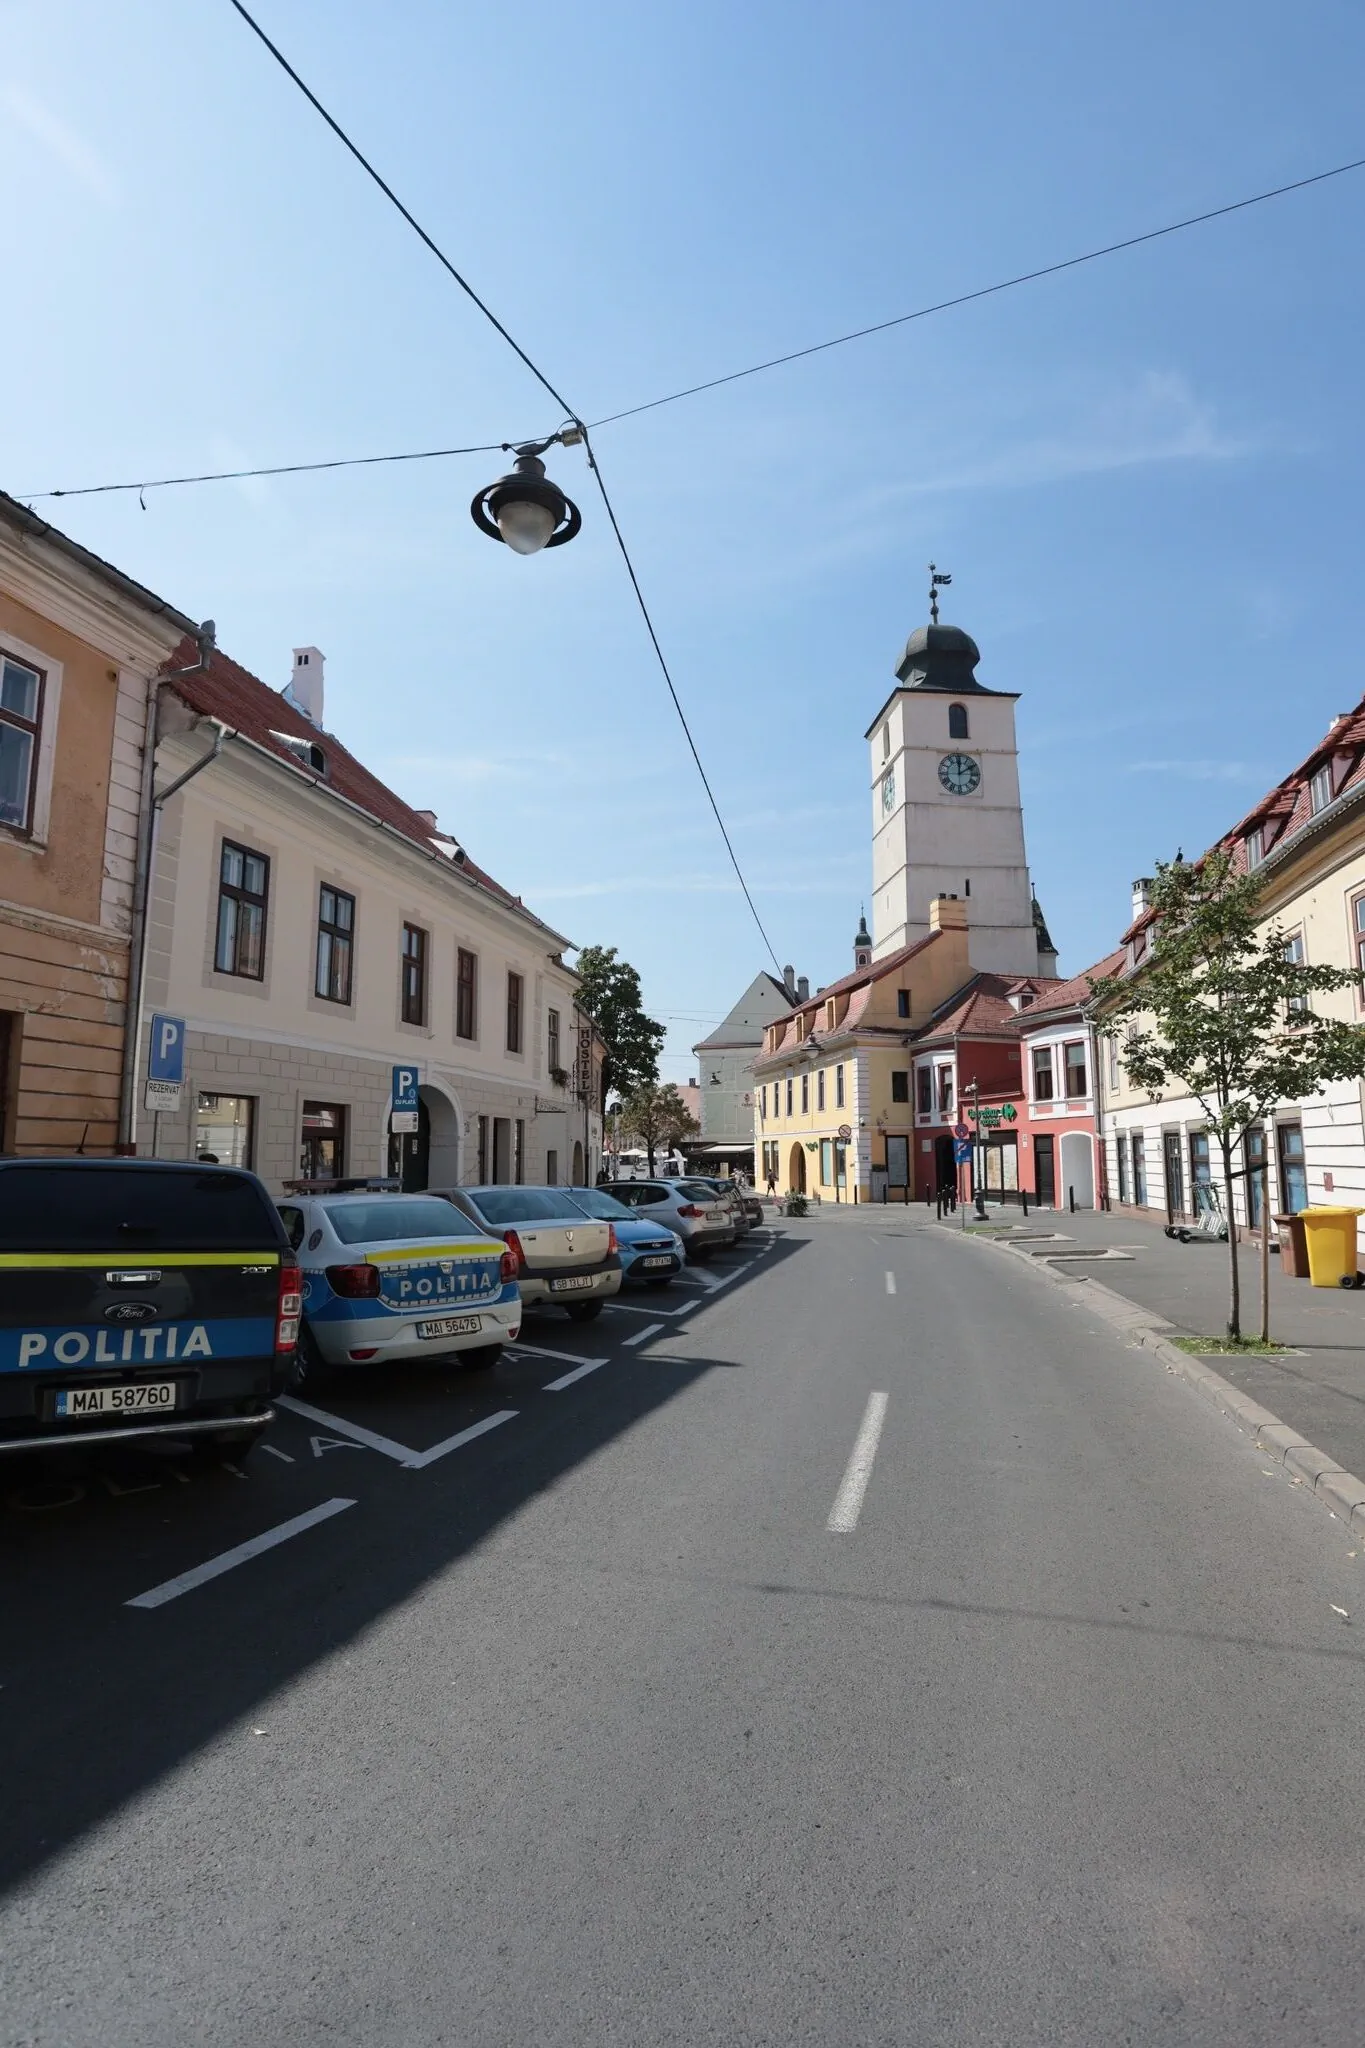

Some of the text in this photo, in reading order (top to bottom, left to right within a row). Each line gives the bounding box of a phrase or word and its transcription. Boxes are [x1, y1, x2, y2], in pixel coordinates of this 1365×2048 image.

[160, 1022, 178, 1059] P
[581, 1029, 590, 1089] HOSTEL
[149, 1083, 180, 1095] REZERVAT
[399, 1071, 412, 1096] P
[400, 1272, 491, 1297] POLITIA
[557, 1279, 567, 1289] SB
[117, 1306, 146, 1319] Ford
[426, 1318, 477, 1336] MAI 56476
[18, 1326, 213, 1368] POLITIA
[73, 1391, 103, 1412] MAI
[112, 1386, 170, 1408] 58760
